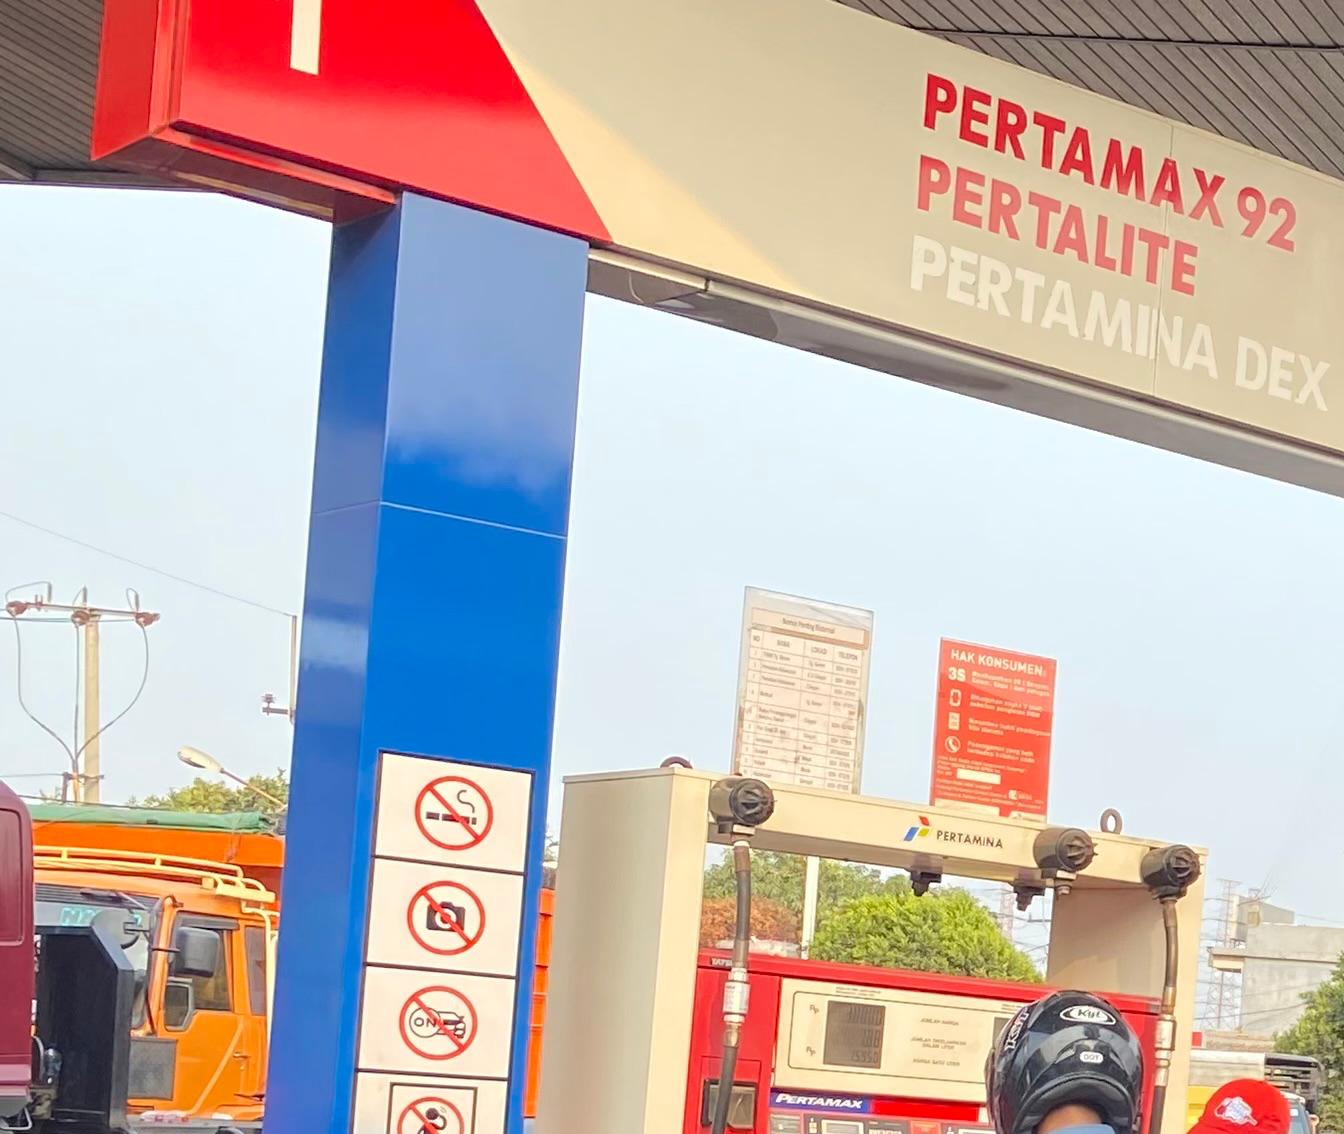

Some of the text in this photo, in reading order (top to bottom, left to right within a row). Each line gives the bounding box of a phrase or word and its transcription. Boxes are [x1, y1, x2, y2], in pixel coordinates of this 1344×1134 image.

[924, 72, 1298, 253] PERTAMAX 92
[917, 154, 1199, 297] PERTALITE
[910, 234, 1332, 412] PERTAMINA DEX
[951, 648, 976, 665] HAK
[948, 667, 966, 682] 3S
[936, 830, 1003, 849] PERTAMINA
[413, 1017, 437, 1028] ON
[776, 1093, 863, 1109] PERTAMAX
